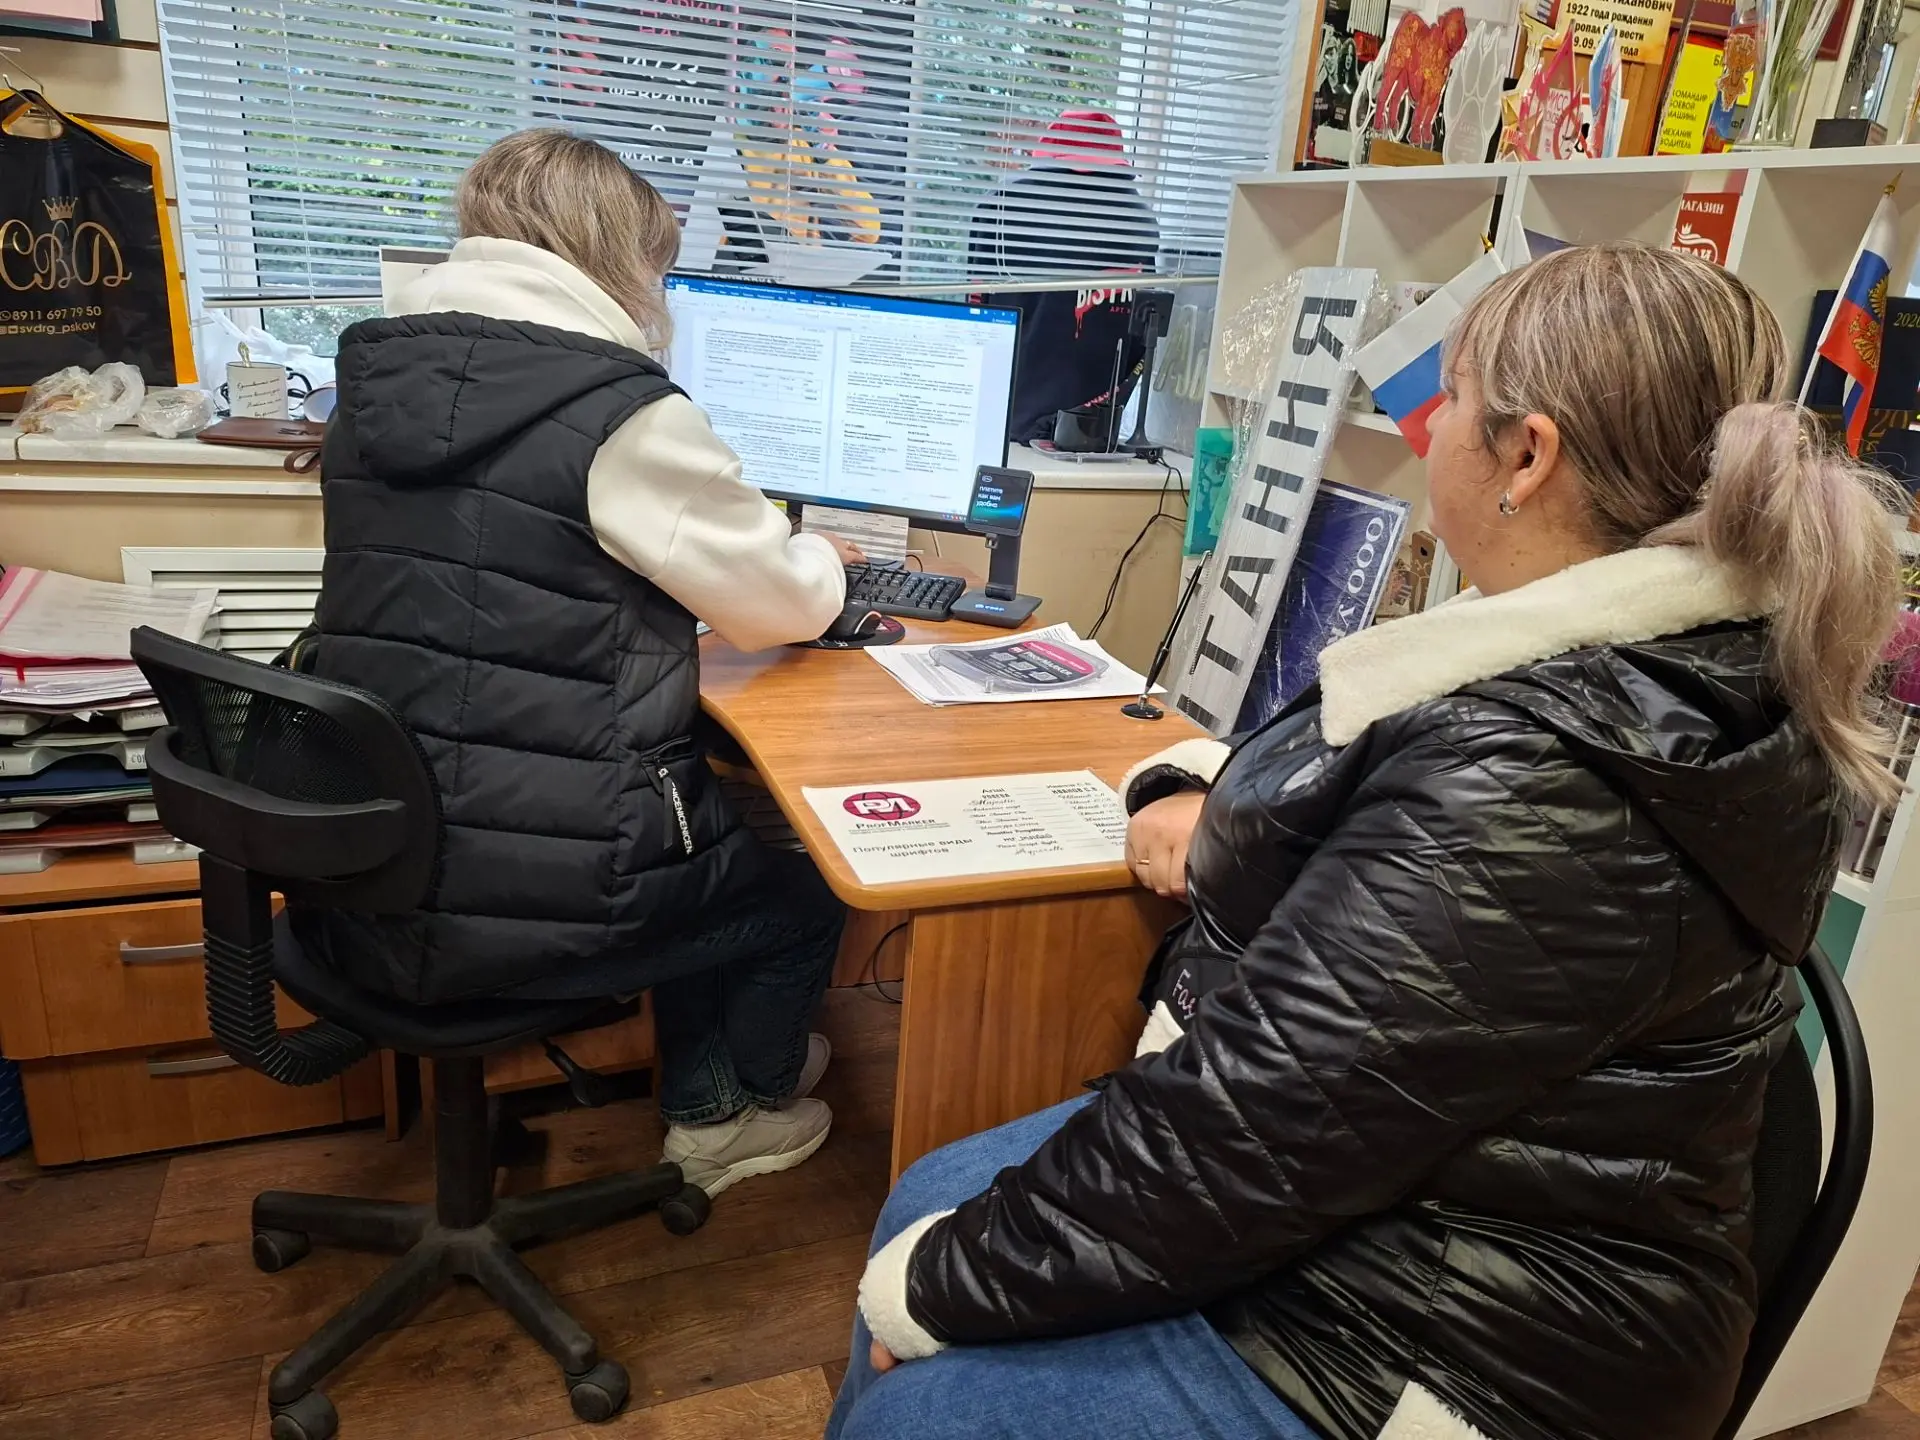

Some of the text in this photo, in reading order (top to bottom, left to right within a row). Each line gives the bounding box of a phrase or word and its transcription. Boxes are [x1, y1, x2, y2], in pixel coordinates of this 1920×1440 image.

[1566, 2, 1654, 27] 1922 года рождения
[1575, 21, 1601, 34] ропал
[1619, 28, 1645, 41] вести
[1620, 45, 1639, 56] года
[12, 305, 102, 321] 8911 697 79 50
[20, 321, 96, 335] svdrg_pskov
[852, 840, 936, 853] Популярные
[938, 838, 973, 846] виды
[889, 847, 949, 857] шрифтов
